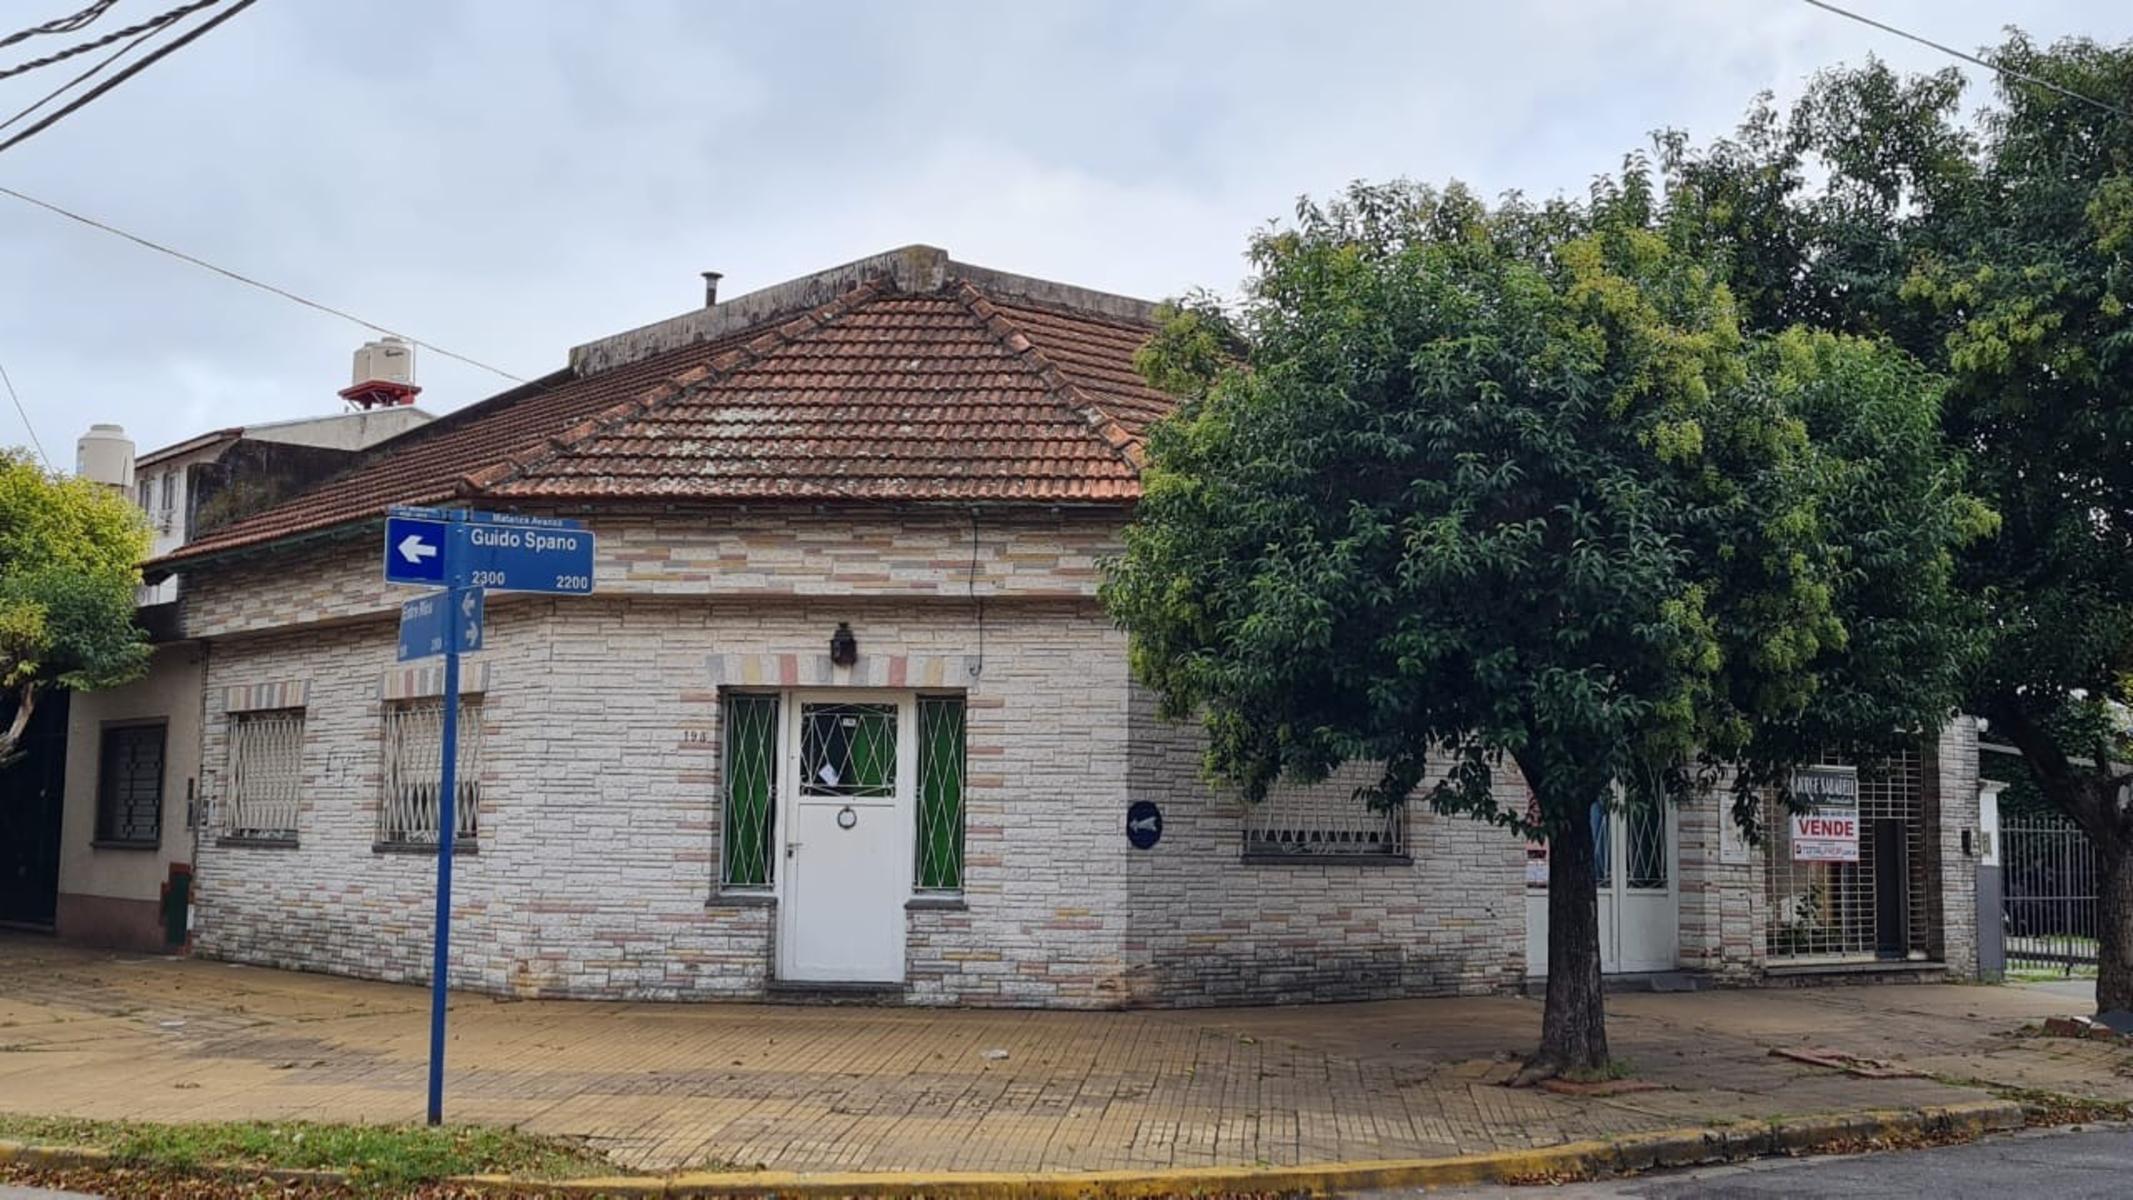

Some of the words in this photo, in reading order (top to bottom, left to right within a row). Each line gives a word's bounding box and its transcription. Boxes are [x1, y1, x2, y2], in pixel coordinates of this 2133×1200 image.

[471, 528, 520, 547] Guido
[524, 531, 577, 553] Spano
[471, 570, 506, 585] 2300
[555, 574, 588, 589] 2200
[1798, 819, 1854, 837] VENDE
